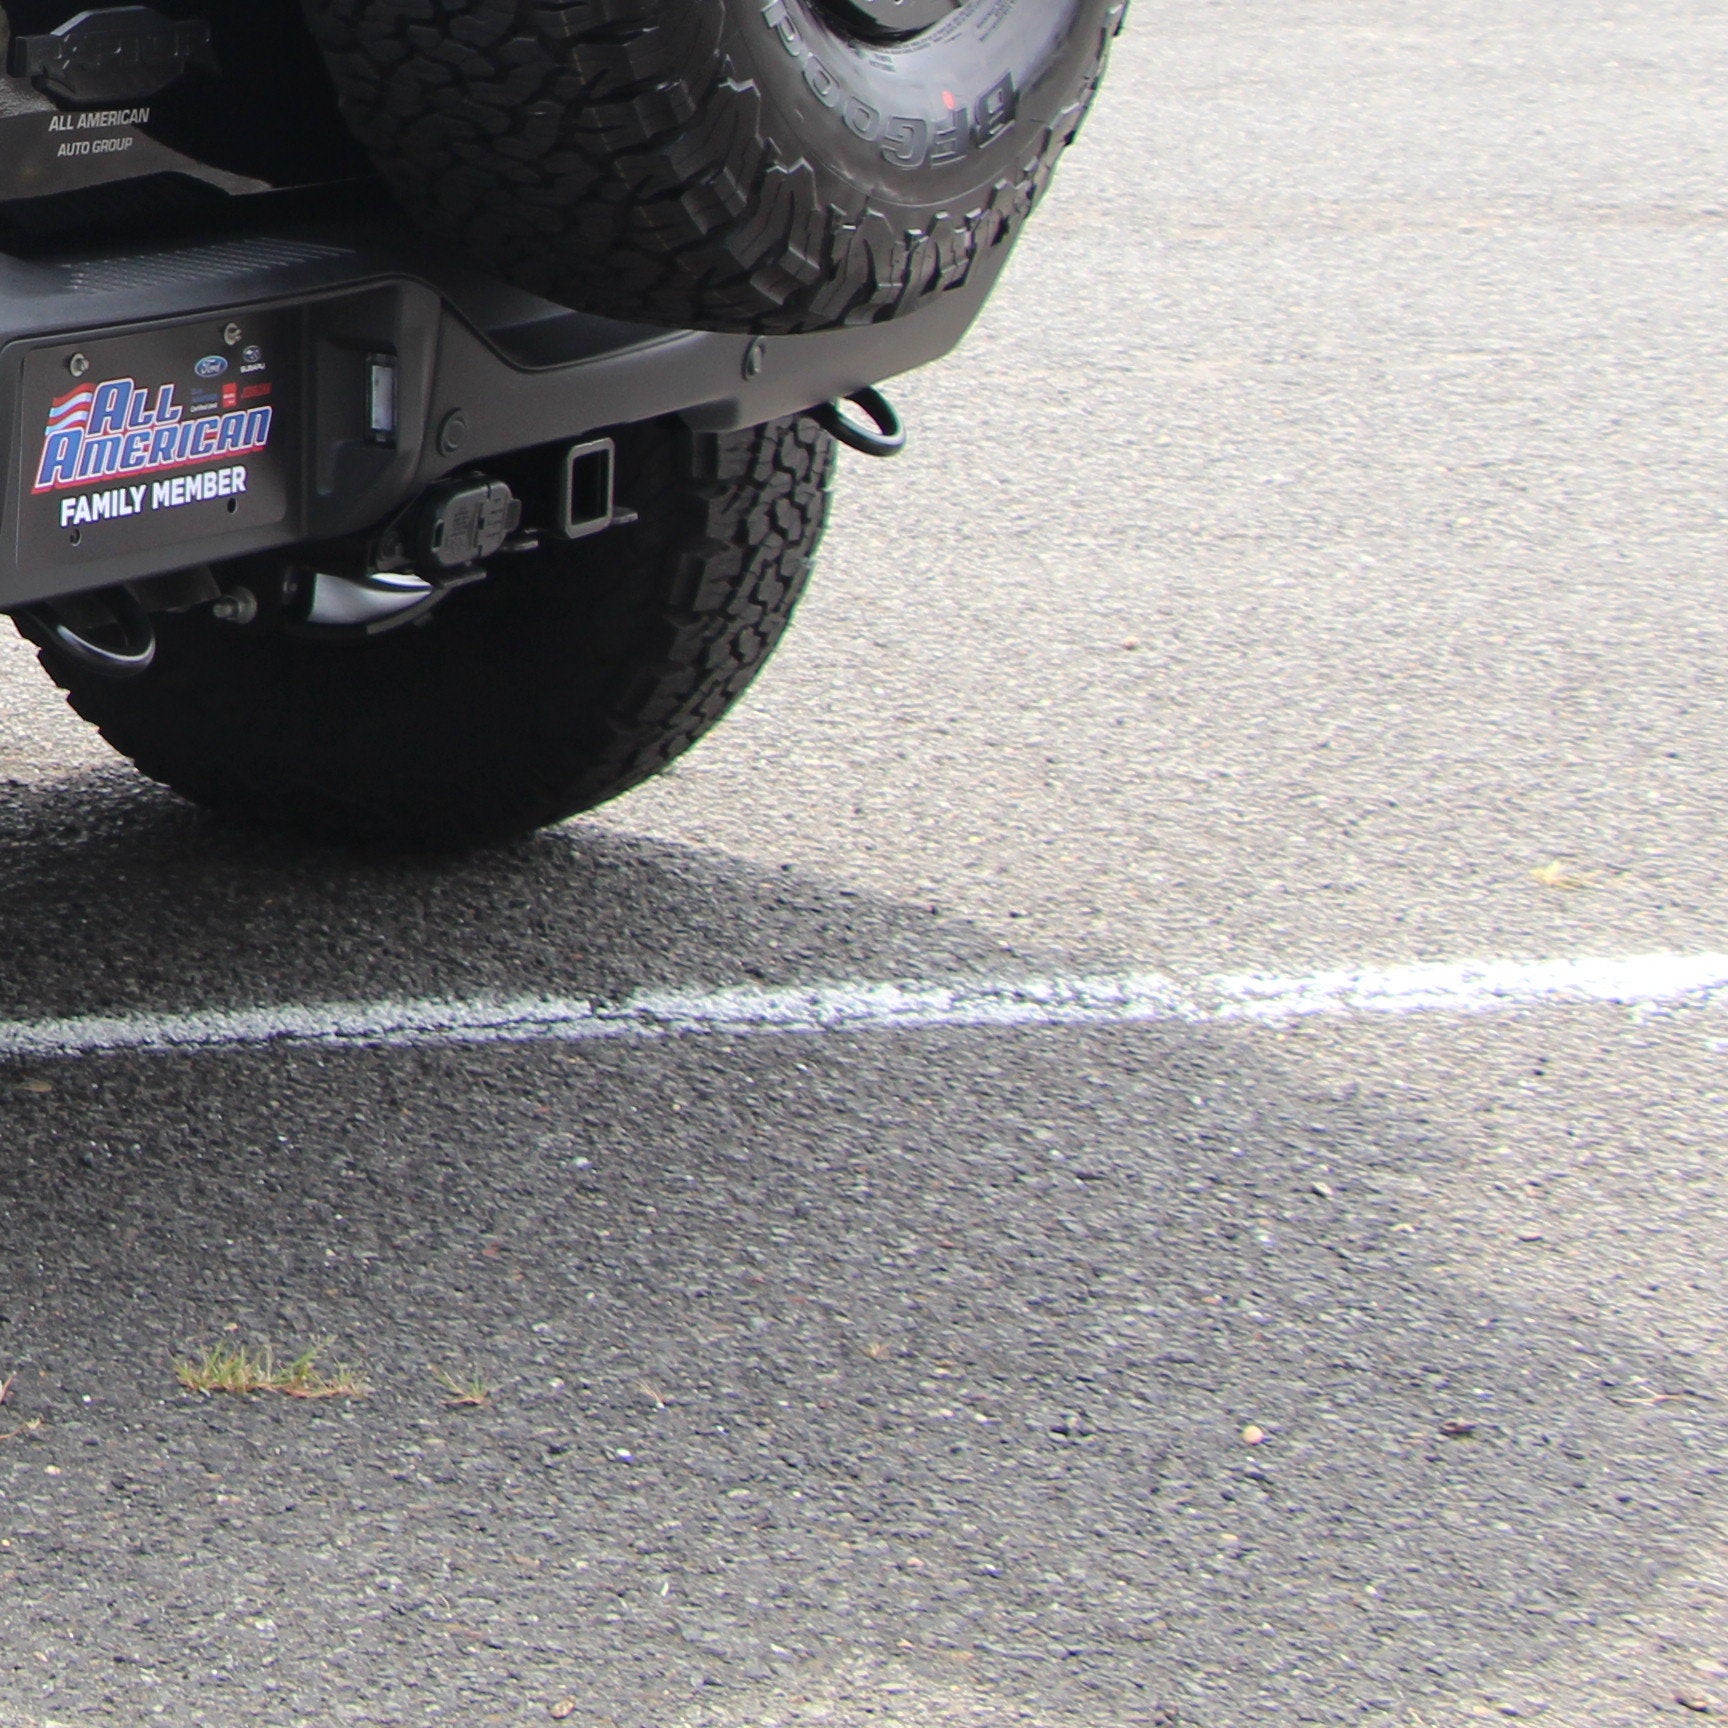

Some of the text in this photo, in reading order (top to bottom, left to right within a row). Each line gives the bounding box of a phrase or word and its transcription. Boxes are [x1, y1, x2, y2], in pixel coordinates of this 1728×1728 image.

[48, 107, 150, 132] ALL AMERICAN
[57, 137, 133, 158] AUTO GROUP
[60, 465, 246, 528] FAMILY MEMBER
